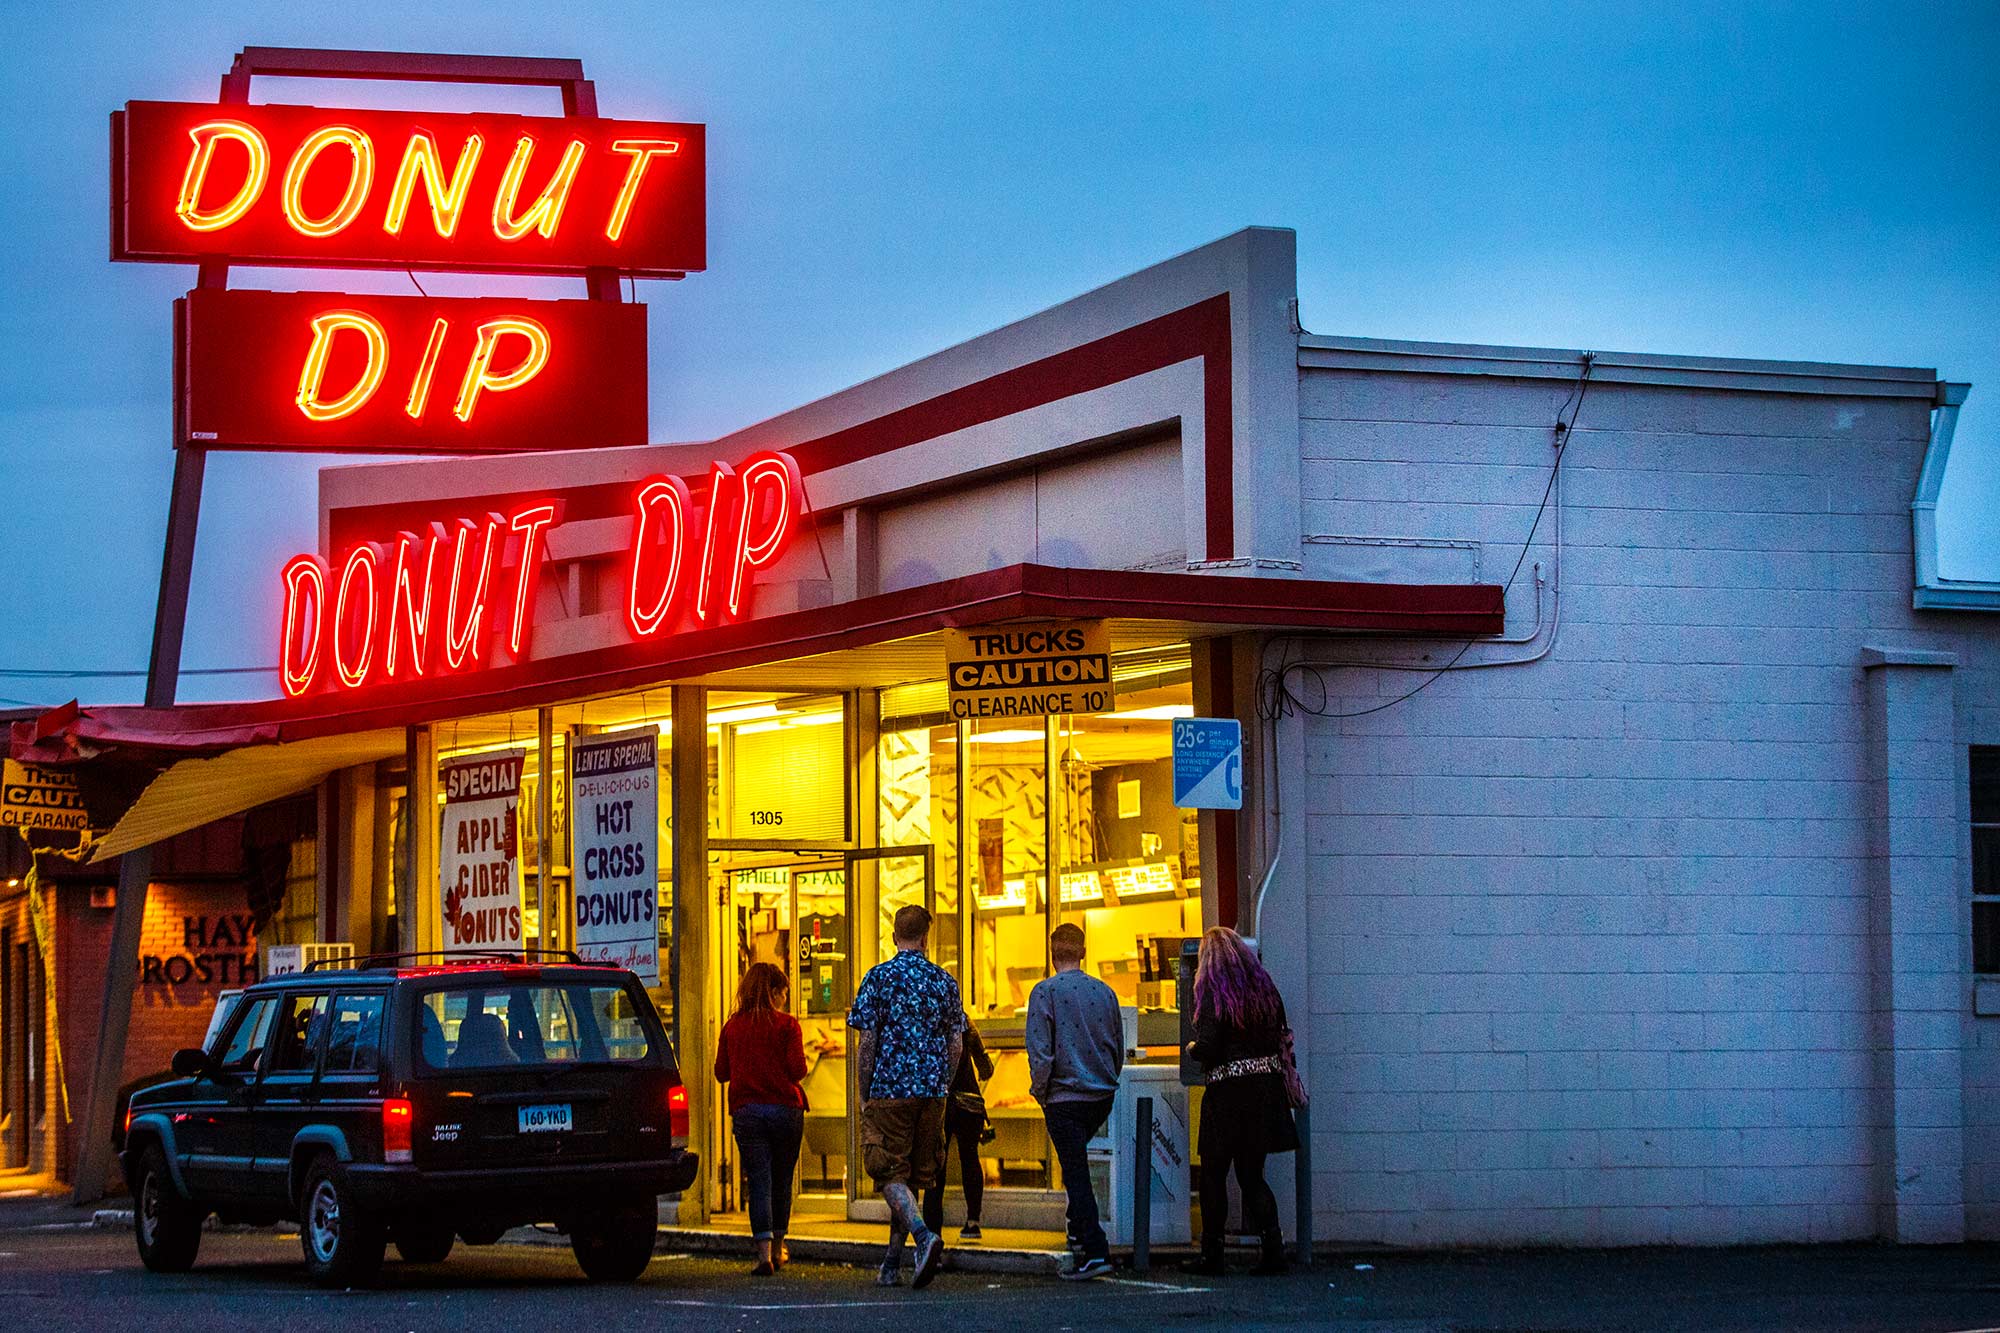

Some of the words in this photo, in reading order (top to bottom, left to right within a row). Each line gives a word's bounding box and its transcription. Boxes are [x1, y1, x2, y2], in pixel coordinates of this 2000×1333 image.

[174, 118, 684, 243] DONUT
[294, 308, 552, 424] DIP
[281, 500, 560, 698] DONUT
[626, 452, 800, 638] DIP
[968, 629, 1085, 656] TRUCKS
[955, 658, 1105, 688] CAUTION
[952, 692, 1074, 719] CLEARANCE
[1081, 690, 1109, 711] 10'
[575, 748, 612, 773] LENTEN
[613, 741, 652, 769] SPECIAL
[7, 786, 84, 807] CAUT
[2, 809, 90, 829] CLEARANC
[595, 799, 634, 836] HOT
[749, 810, 783, 825] 1305
[584, 842, 645, 881] CROSS
[457, 861, 511, 900] CIDER
[576, 888, 654, 927] DONUTS
[625, 944, 652, 967] Home
[432, 1131, 458, 1142] Jeep
